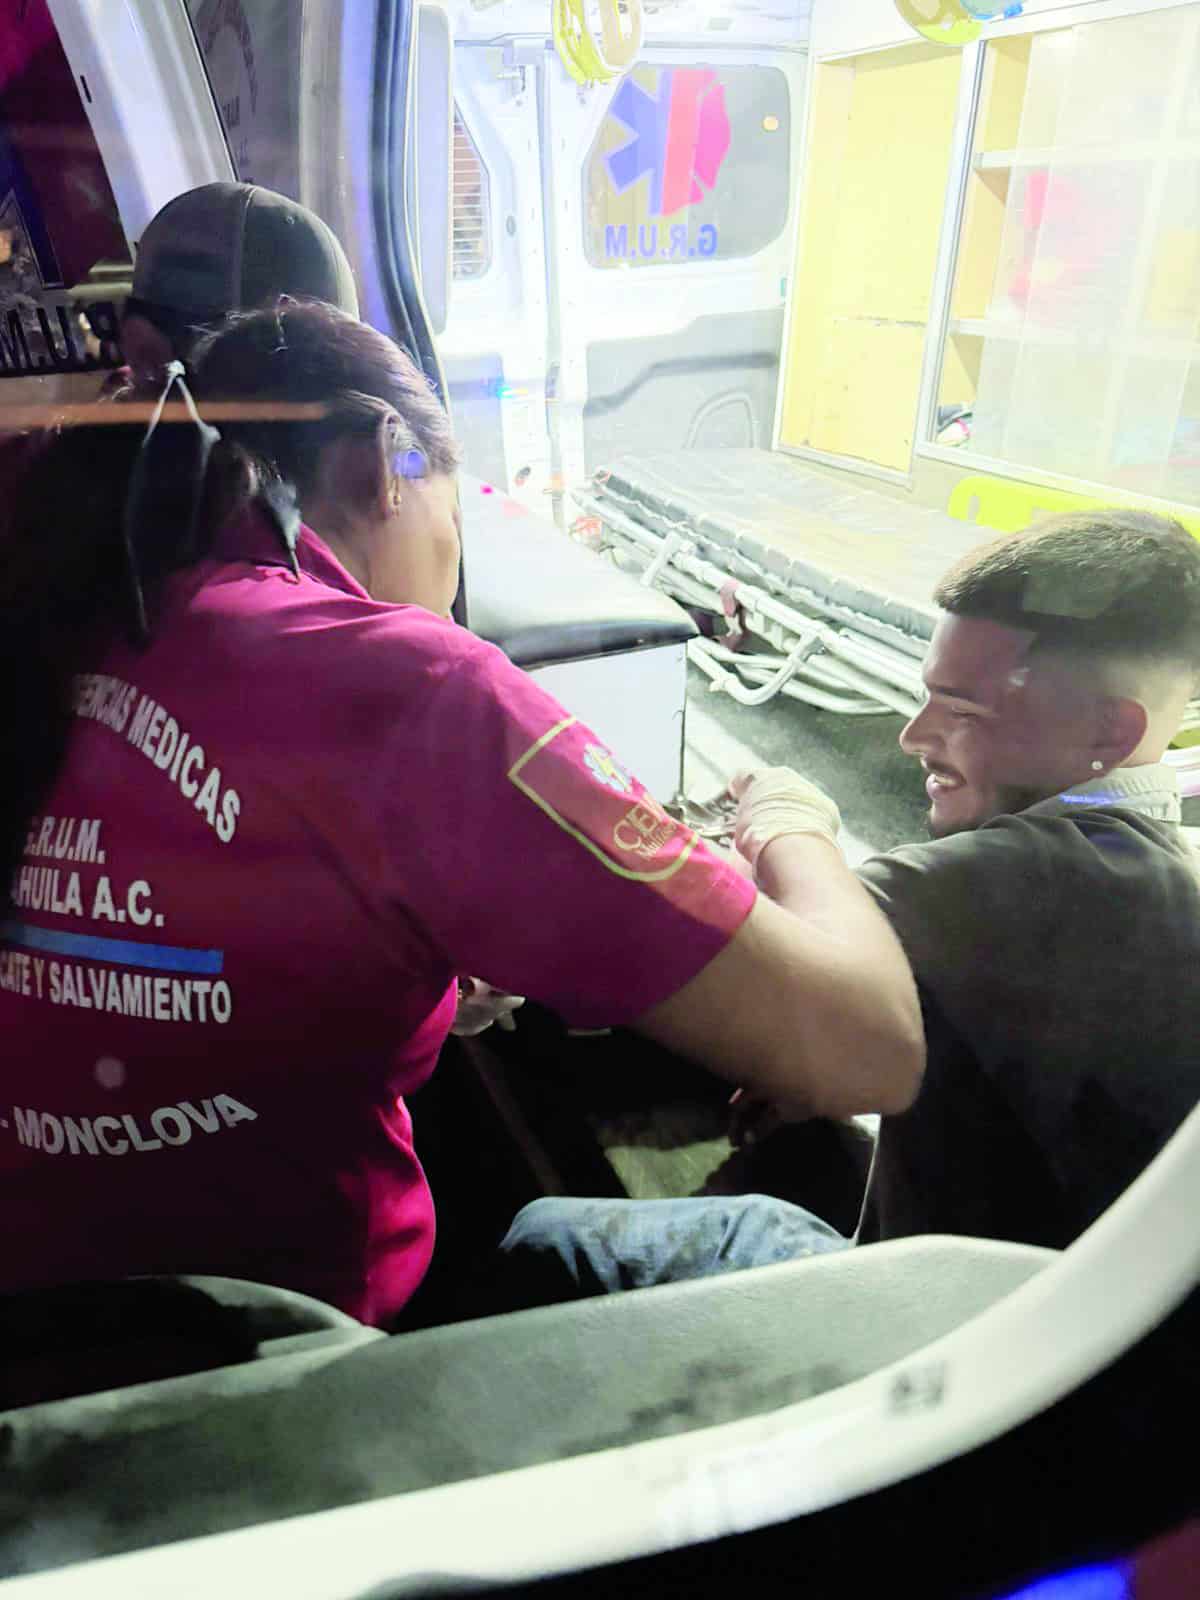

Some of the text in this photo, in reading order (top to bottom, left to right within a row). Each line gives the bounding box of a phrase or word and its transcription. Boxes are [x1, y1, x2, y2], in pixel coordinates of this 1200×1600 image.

[126, 694, 241, 844] MEDICAS
[92, 875, 166, 928] A.C.
[32, 957, 45, 1000] Y
[48, 961, 232, 1024] SALVAMIENTO
[12, 1092, 259, 1156] MONCLOVA
